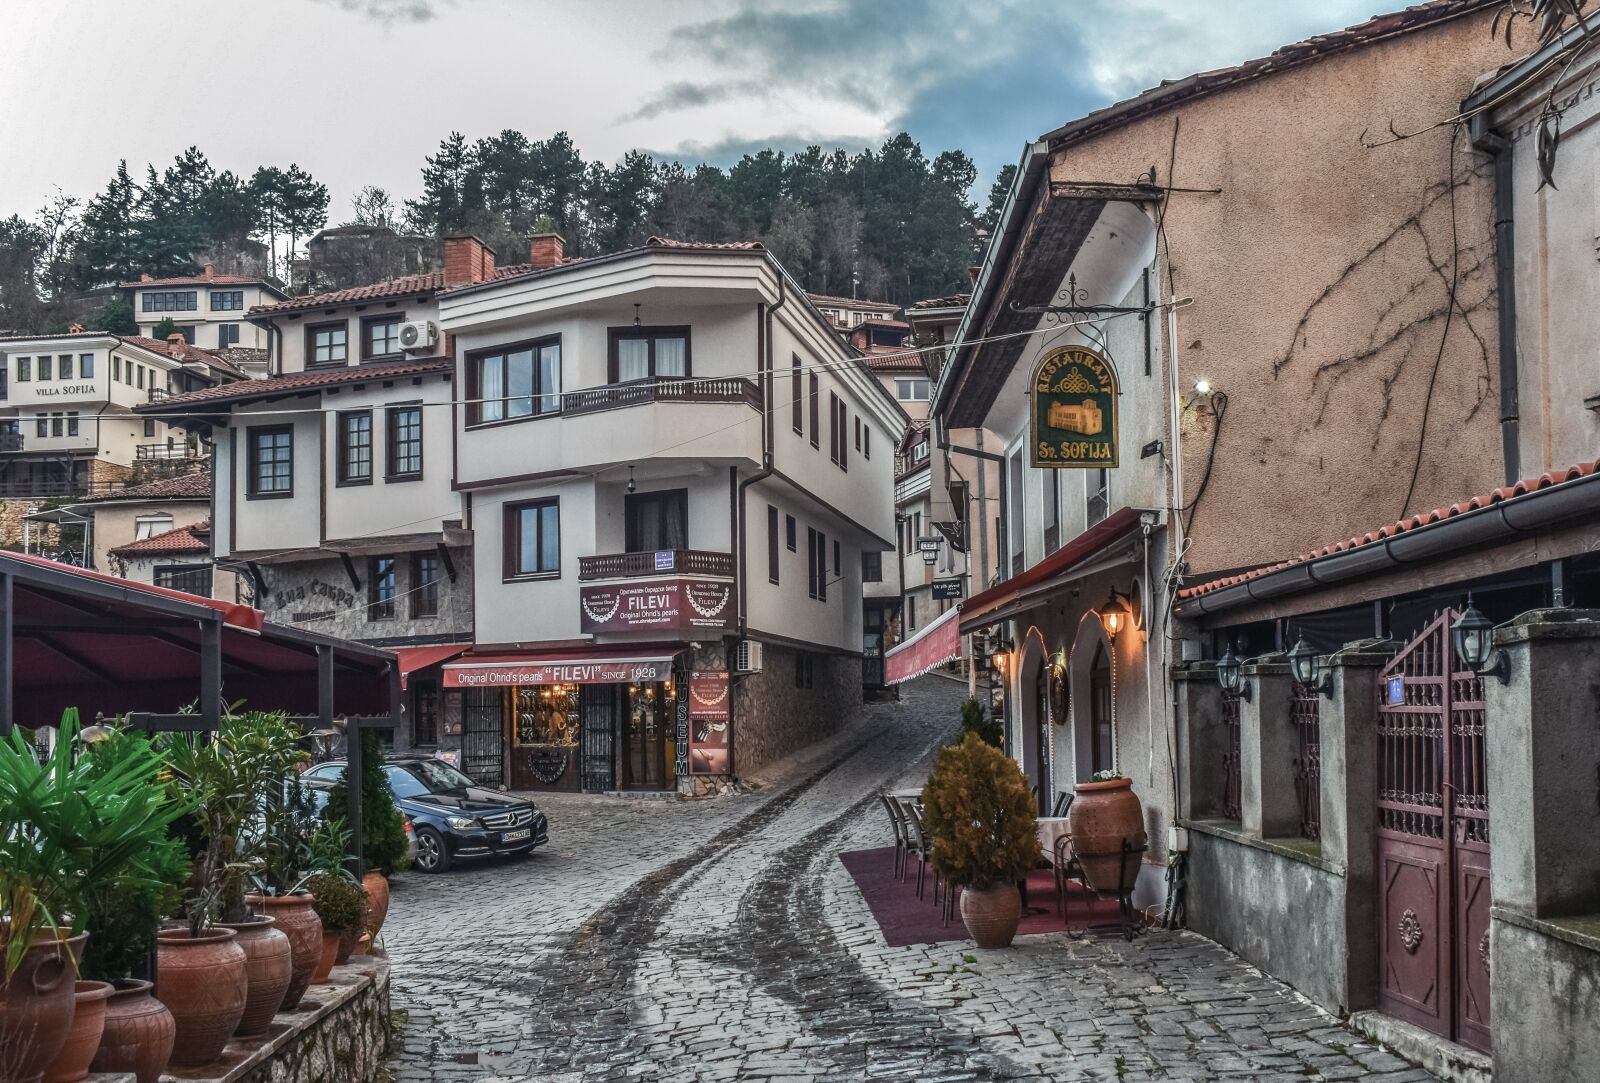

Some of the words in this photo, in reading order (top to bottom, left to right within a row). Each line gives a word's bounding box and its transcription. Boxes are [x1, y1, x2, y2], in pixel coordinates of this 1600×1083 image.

[1038, 353, 1111, 394] RESTAURANT
[36, 388, 60, 396] VILLA
[62, 385, 96, 395] SOFIJA
[1061, 442, 1111, 459] SOFIJA
[628, 594, 670, 610] FILEVI
[620, 611, 640, 619] Original
[641, 610, 661, 618] Ohrid's
[661, 608, 679, 617] pearls
[458, 673, 488, 684] Original
[489, 671, 517, 682] Ohrid's
[518, 669, 543, 681] pearls
[601, 671, 626, 679] SINCE
[630, 667, 656, 679] 1928
[676, 670, 688, 775] MUSEUM
